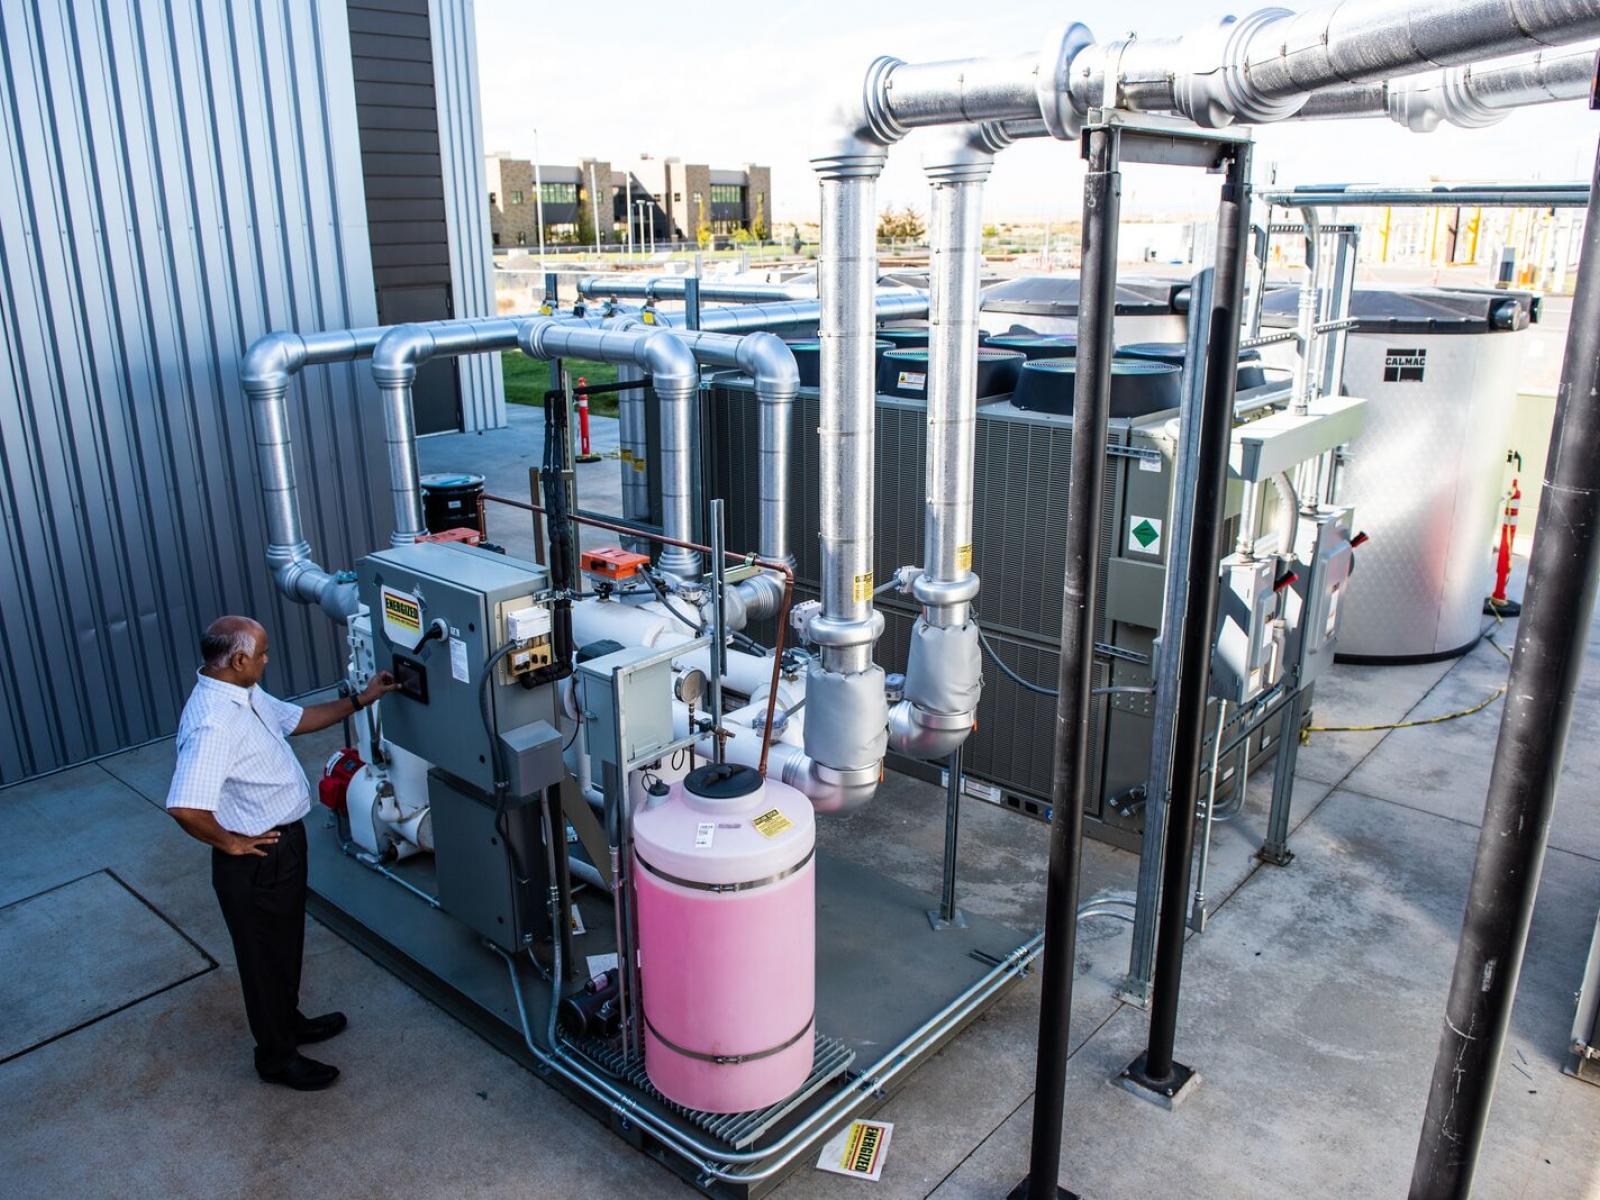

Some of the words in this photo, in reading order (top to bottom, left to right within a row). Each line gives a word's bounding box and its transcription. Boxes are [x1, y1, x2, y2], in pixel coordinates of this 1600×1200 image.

[1385, 357, 1426, 366] CALMAC
[385, 598, 418, 619] ENERGIZED
[855, 1126, 879, 1173] ENERGIZED
